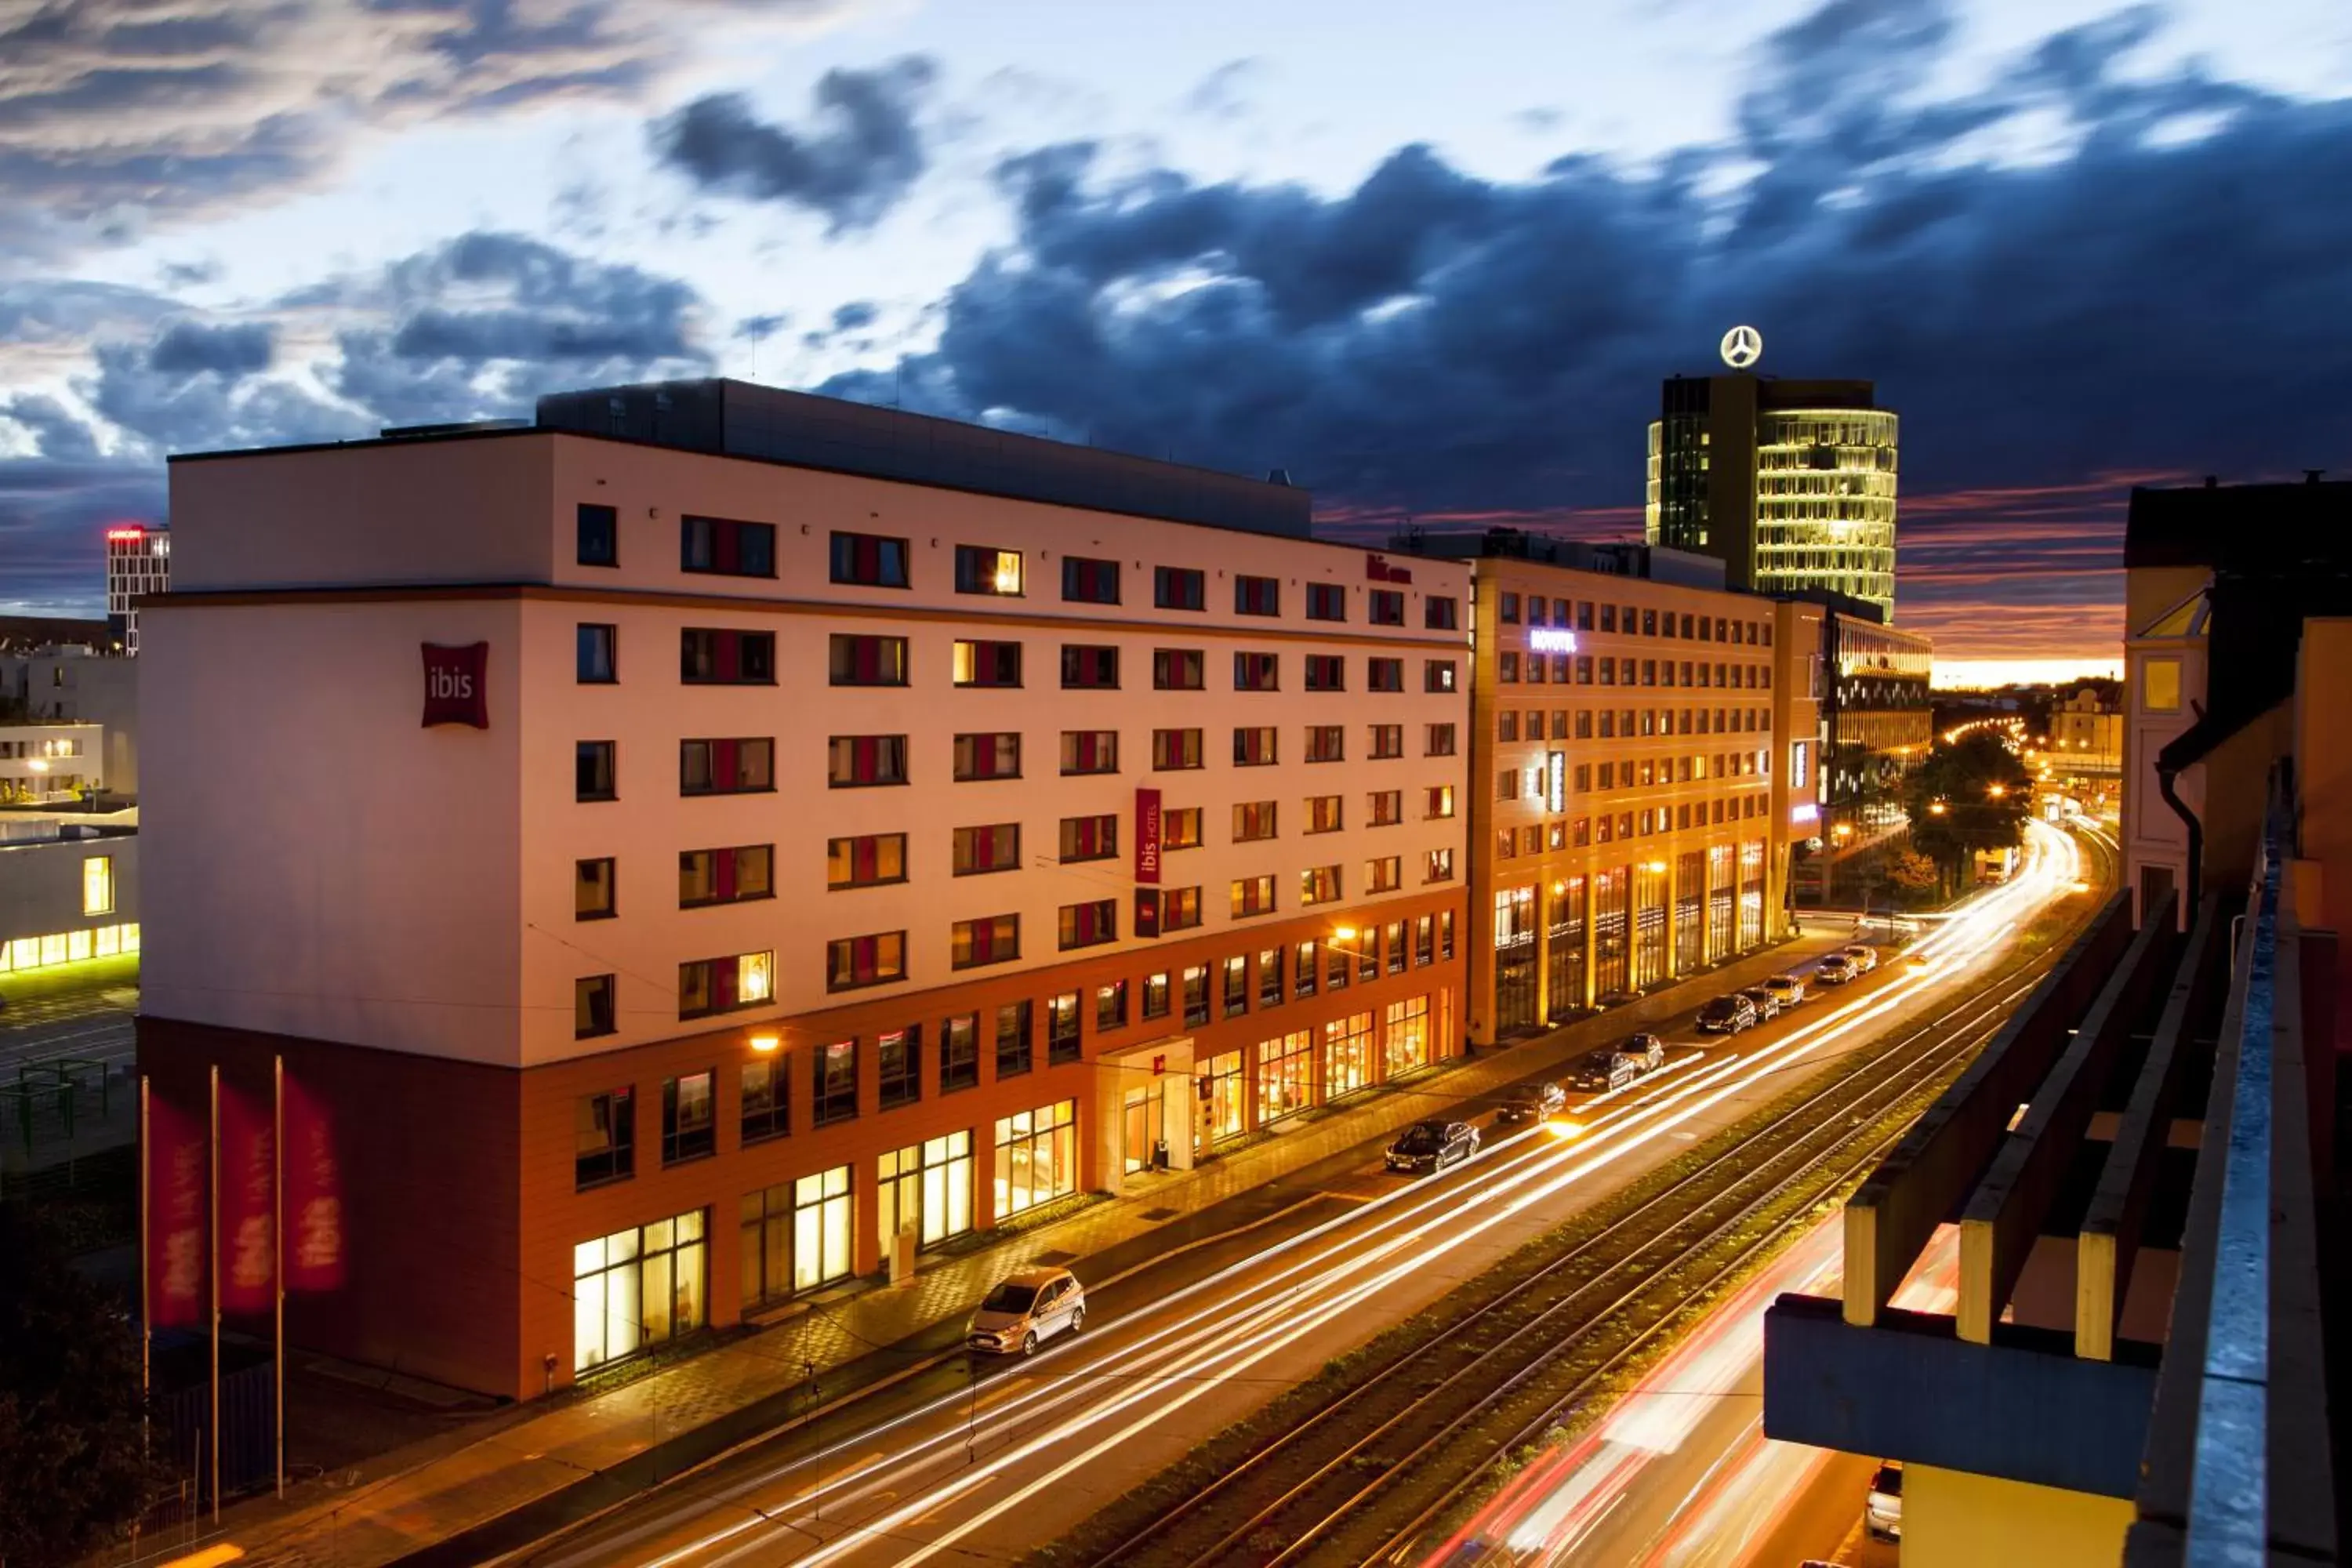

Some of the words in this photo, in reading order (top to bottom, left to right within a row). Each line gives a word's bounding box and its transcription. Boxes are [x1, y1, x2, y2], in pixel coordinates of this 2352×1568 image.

[431, 666, 472, 699] ibis
[1148, 804, 1158, 839] HOTEL
[1142, 842, 1157, 872] ibis
